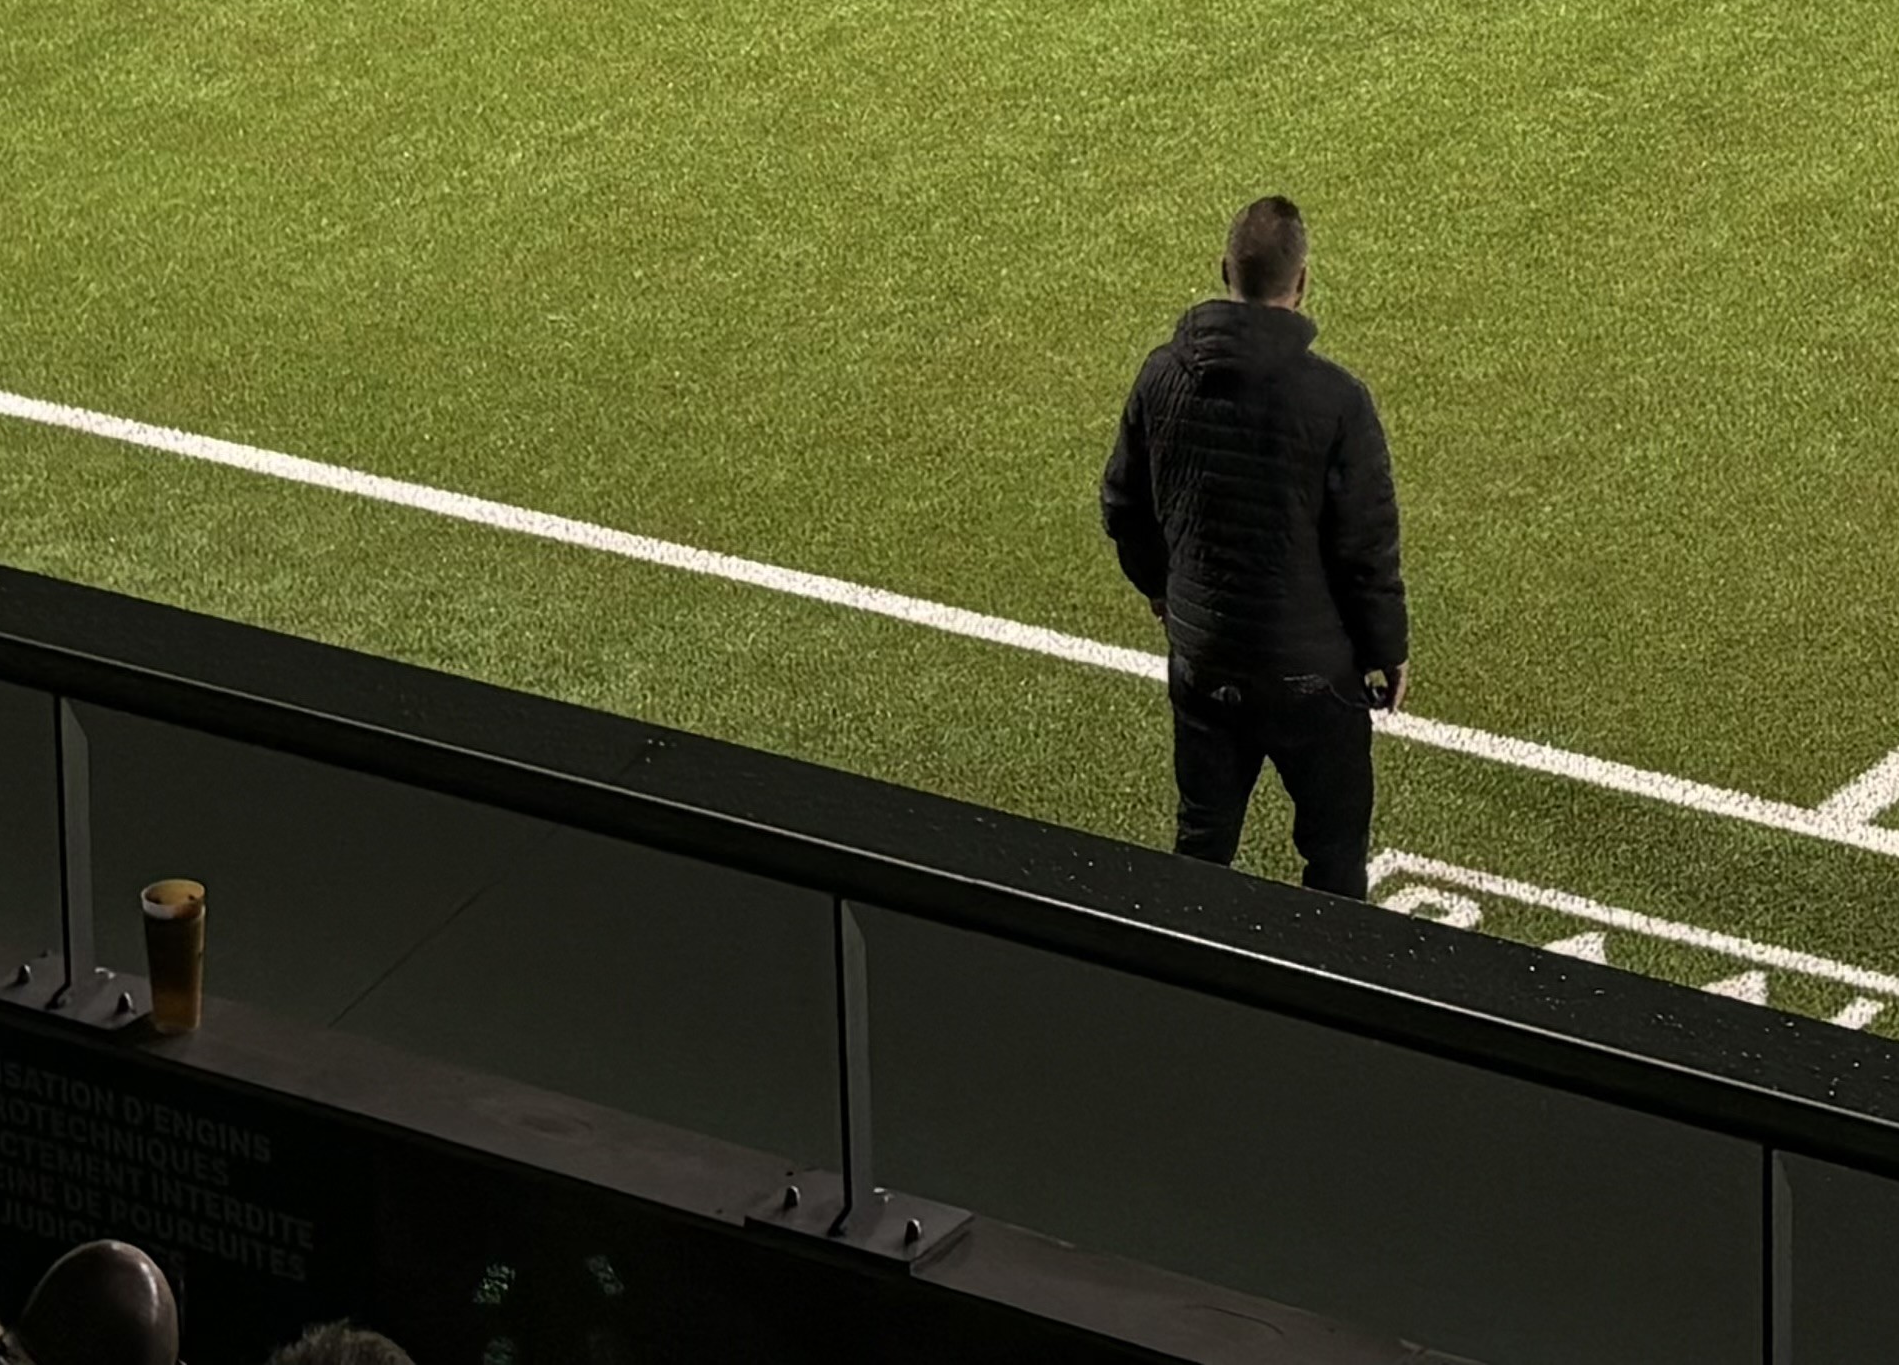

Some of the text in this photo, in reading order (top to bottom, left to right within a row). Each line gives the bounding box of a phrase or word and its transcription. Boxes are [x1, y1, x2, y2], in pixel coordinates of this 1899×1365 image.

[121, 1093, 272, 1164] D'ENGINS
[62, 1181, 102, 1220] DE
[109, 1189, 308, 1283] POURSUITES
[151, 1173, 315, 1252] INTERDITE
